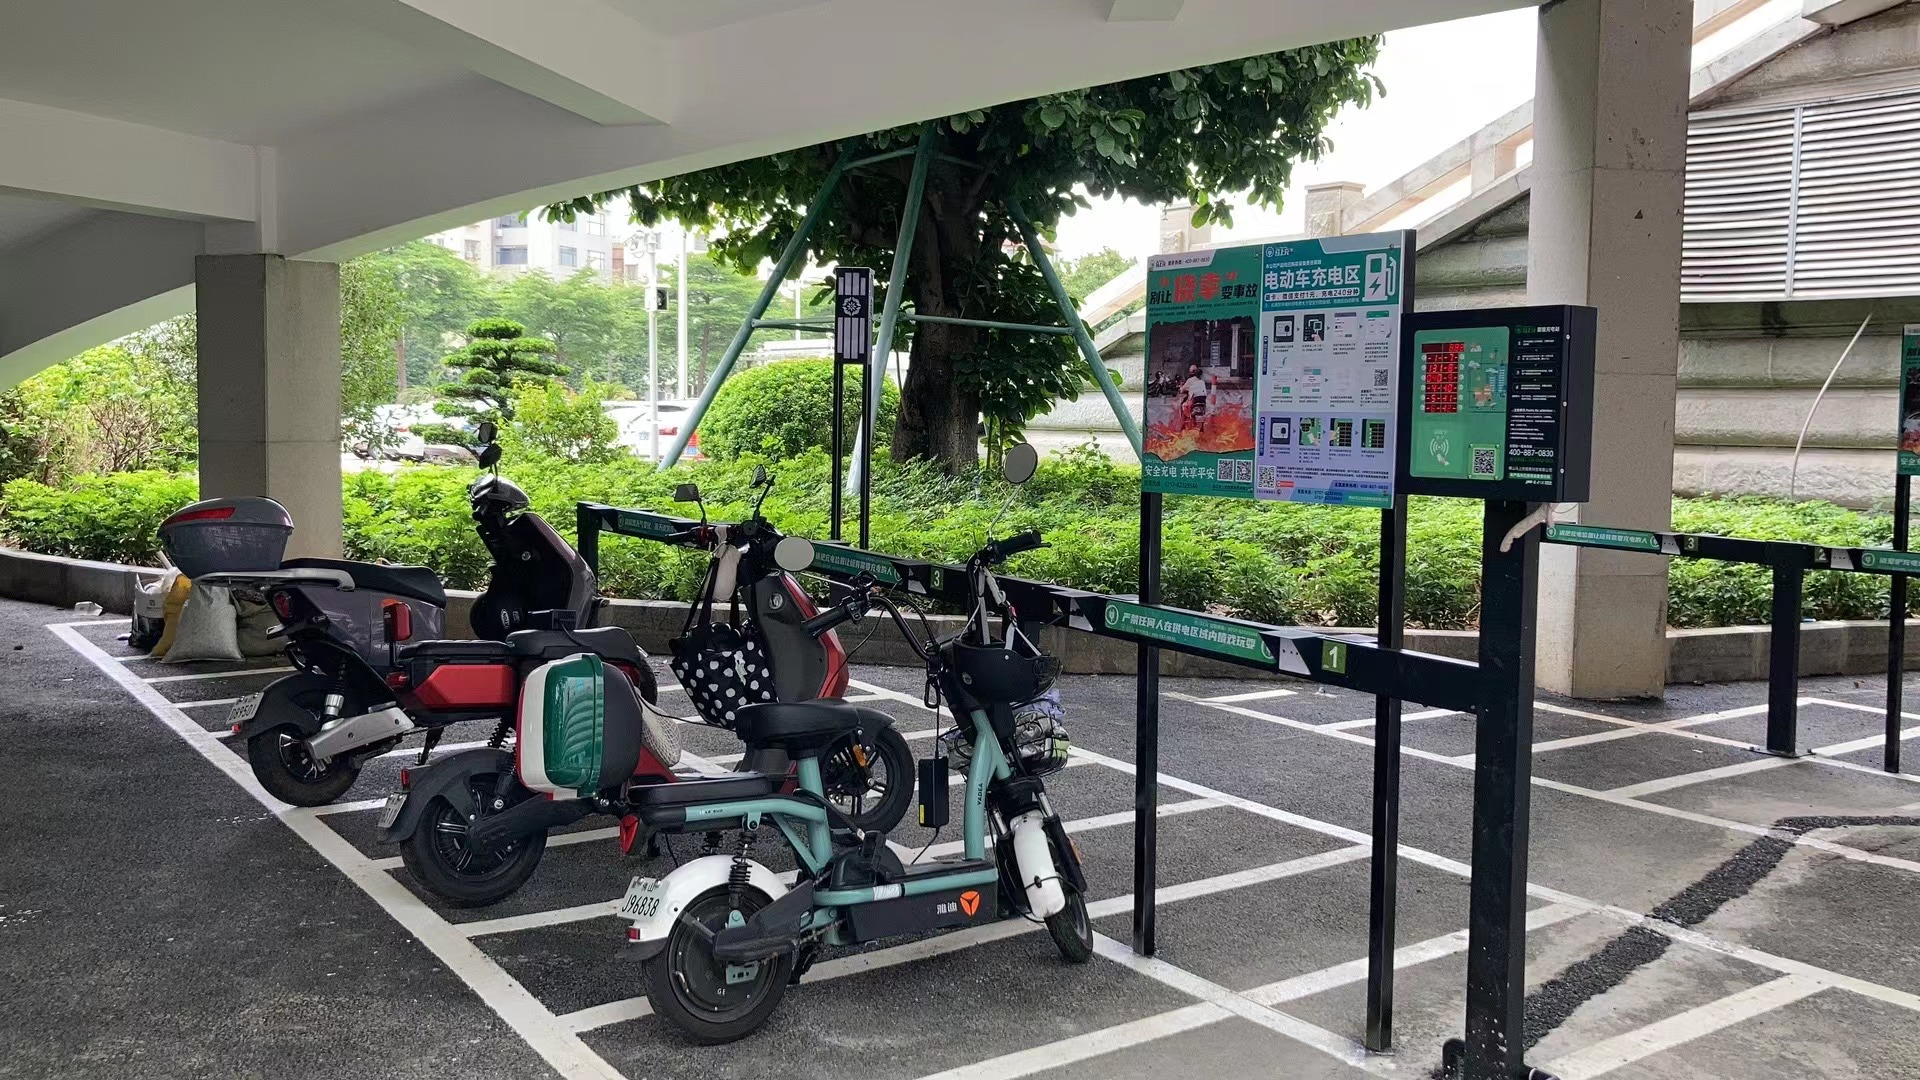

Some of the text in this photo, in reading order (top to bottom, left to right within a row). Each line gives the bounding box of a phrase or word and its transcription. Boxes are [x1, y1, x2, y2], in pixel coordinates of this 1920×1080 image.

[1264, 264, 1360, 290] 电动车充电区
[1509, 449, 1554, 457] 400-887-0830
[1144, 465, 1215, 480] 安全充电 共享平安
[1688, 537, 1694, 549] 3
[1819, 548, 1826, 560] 2
[934, 570, 940, 587] 3
[1121, 612, 1256, 650] 严禁任何人在供电区域内嬉戏玩耍
[1329, 646, 1339, 667] 1
[622, 894, 660, 917] J96838
